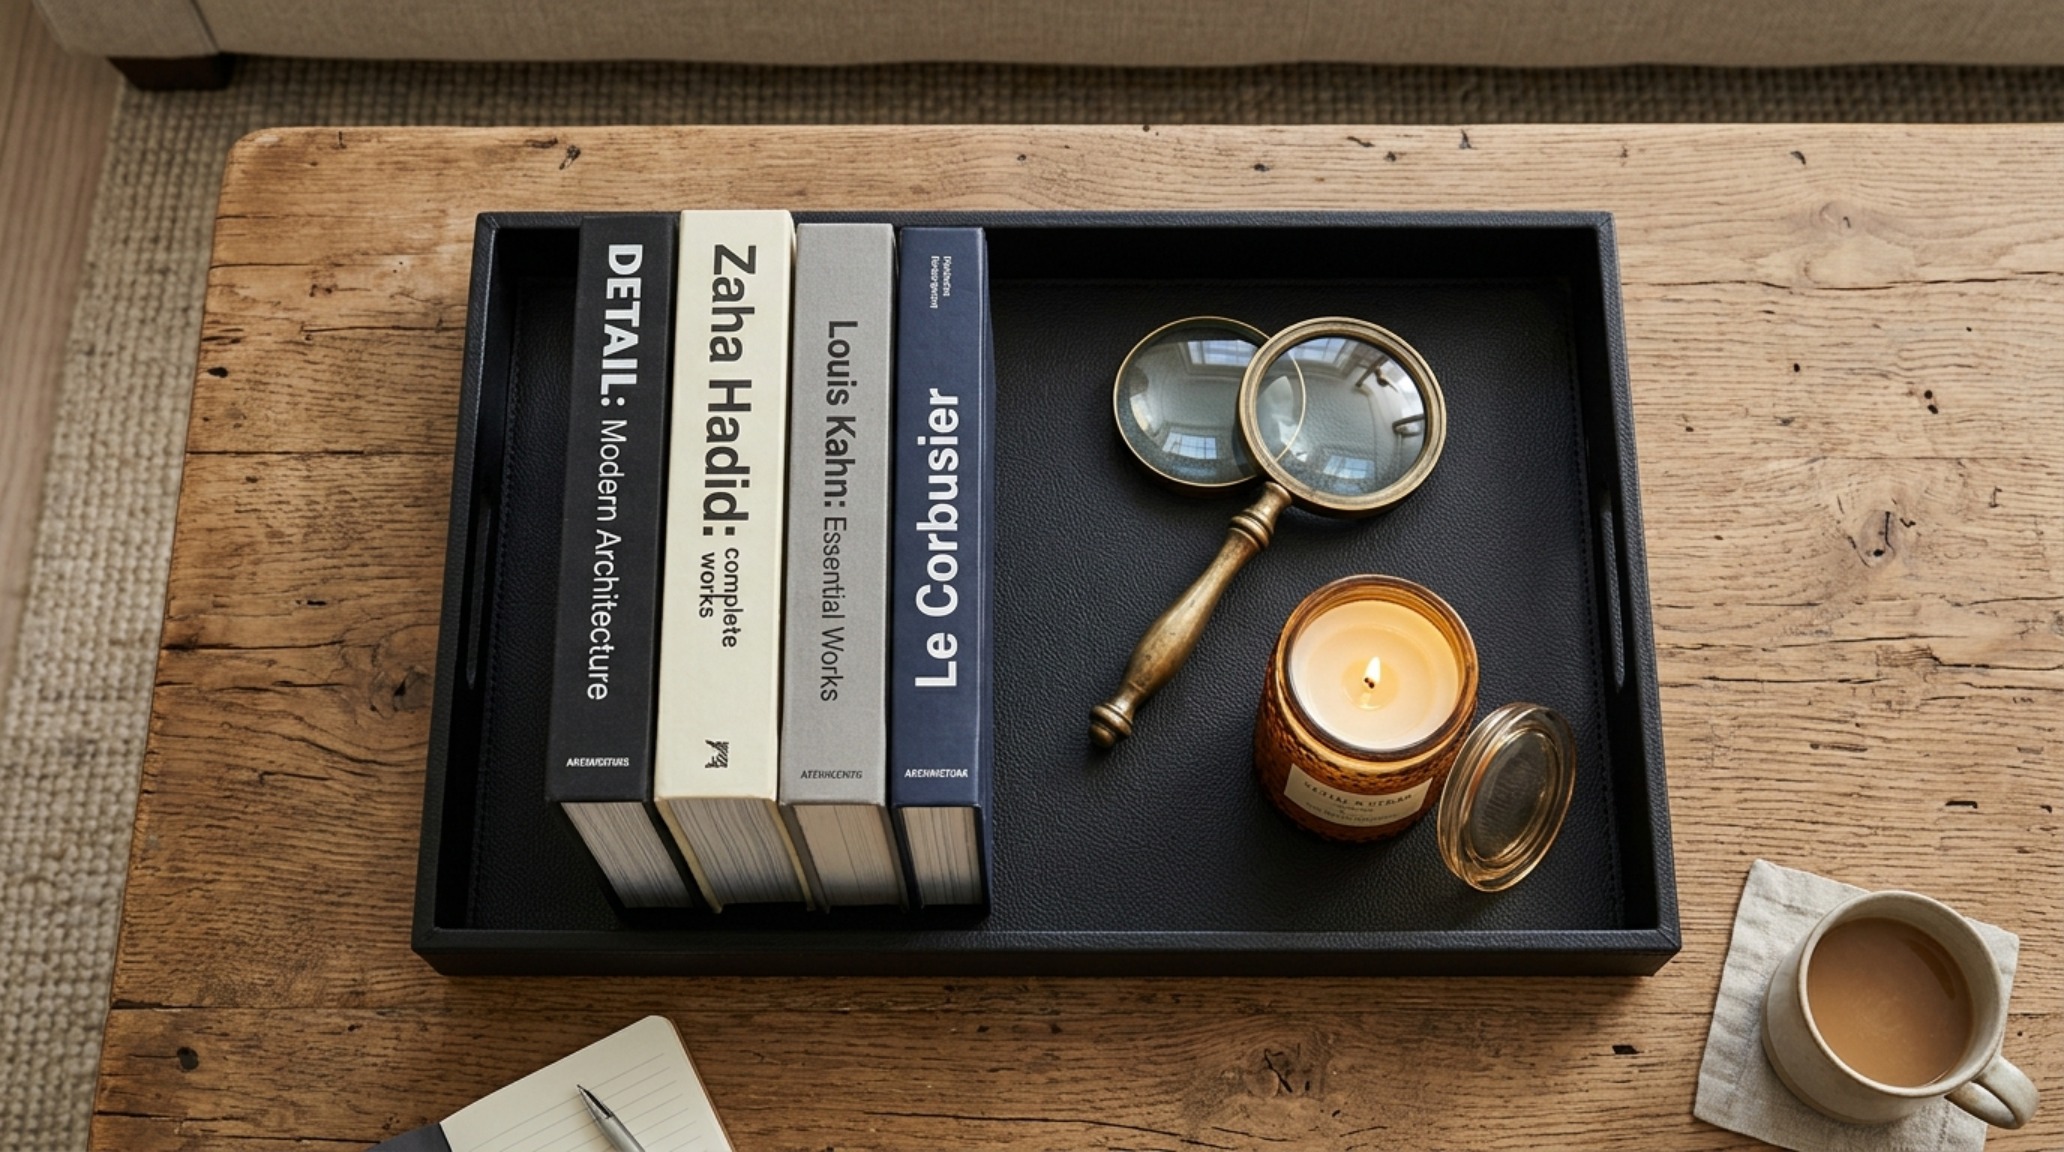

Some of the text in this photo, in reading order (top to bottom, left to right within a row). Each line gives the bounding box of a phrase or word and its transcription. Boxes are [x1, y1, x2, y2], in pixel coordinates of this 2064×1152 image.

[587, 244, 643, 700] DETAIL: Modern Architecture
[699, 552, 717, 619] works
[703, 244, 757, 648] Zaha Hadid: complete
[820, 321, 858, 701] Louis Kahn: Essential Works
[915, 388, 959, 687] Le Corbusier
